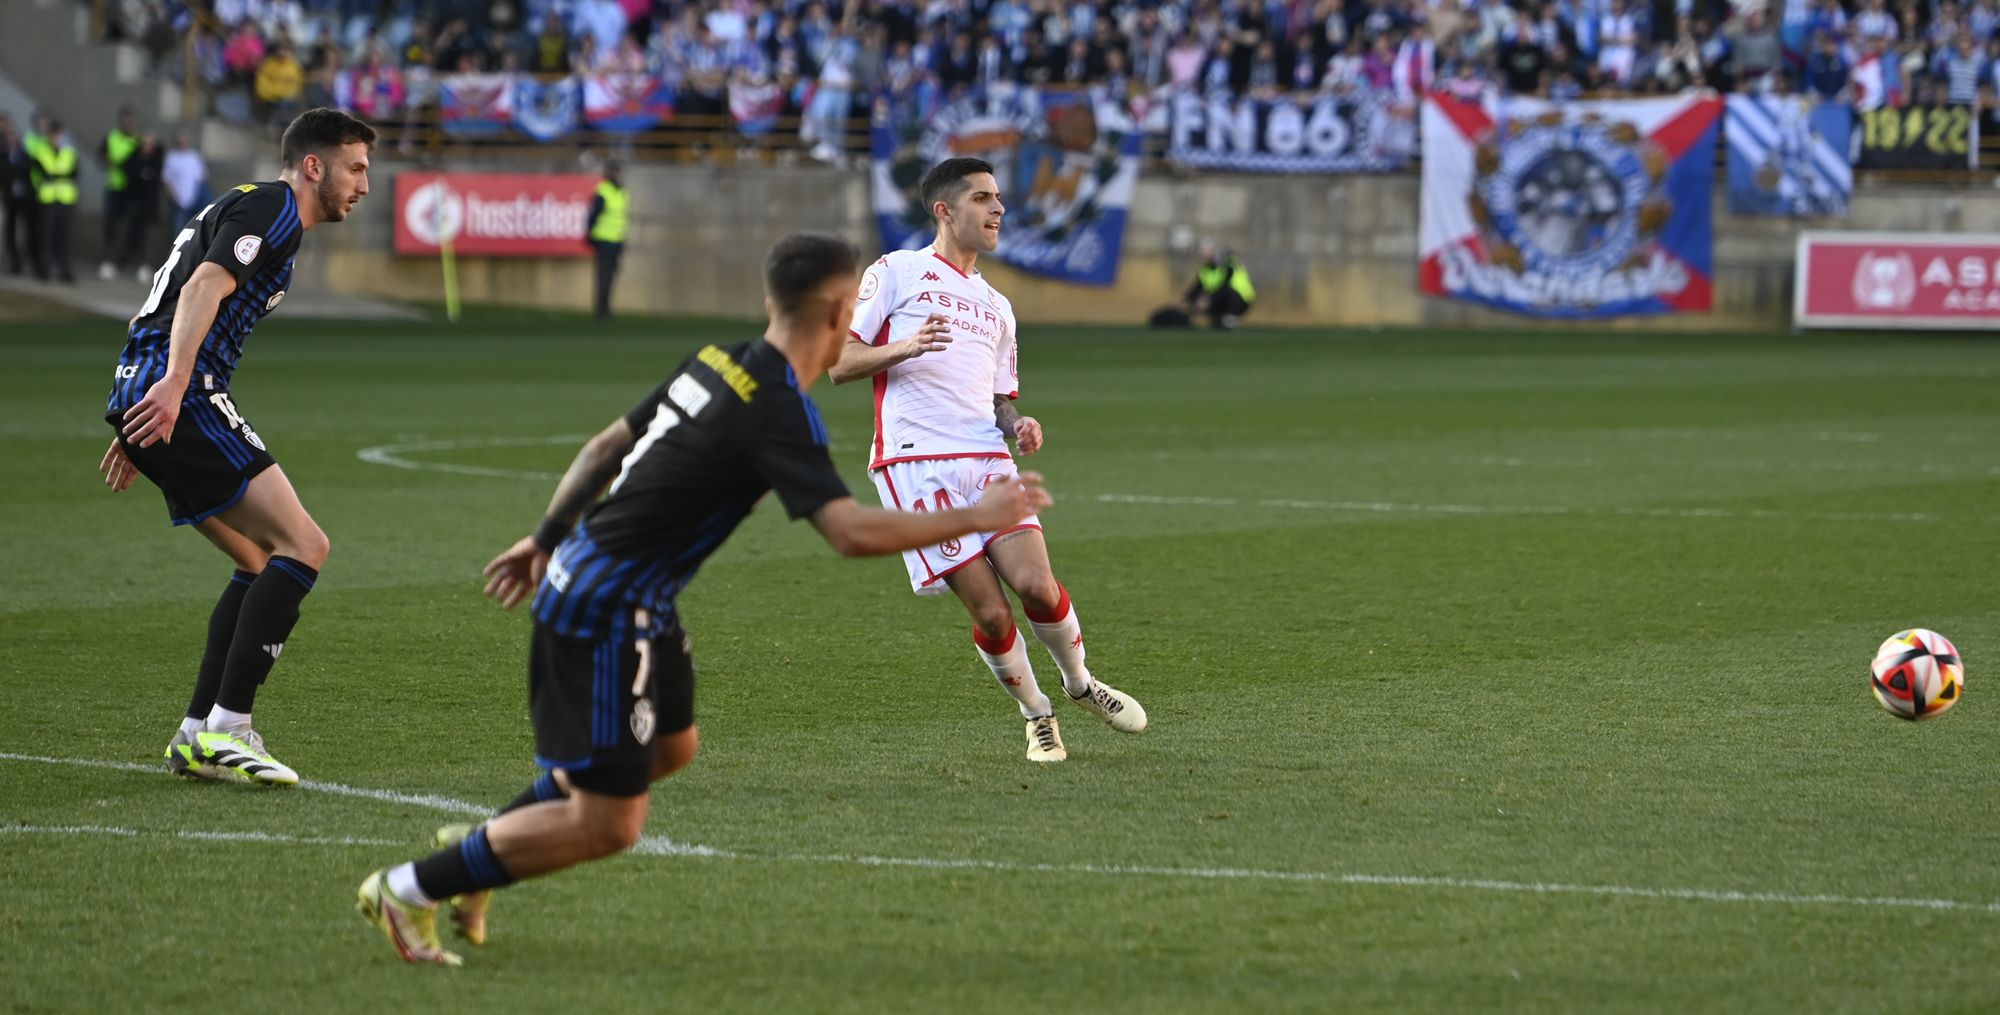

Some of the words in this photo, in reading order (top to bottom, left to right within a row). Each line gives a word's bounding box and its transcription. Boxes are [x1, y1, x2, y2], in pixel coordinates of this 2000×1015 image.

[943, 315, 996, 342] ADEMY
[608, 402, 681, 497] 7
[632, 639, 651, 697] 7
